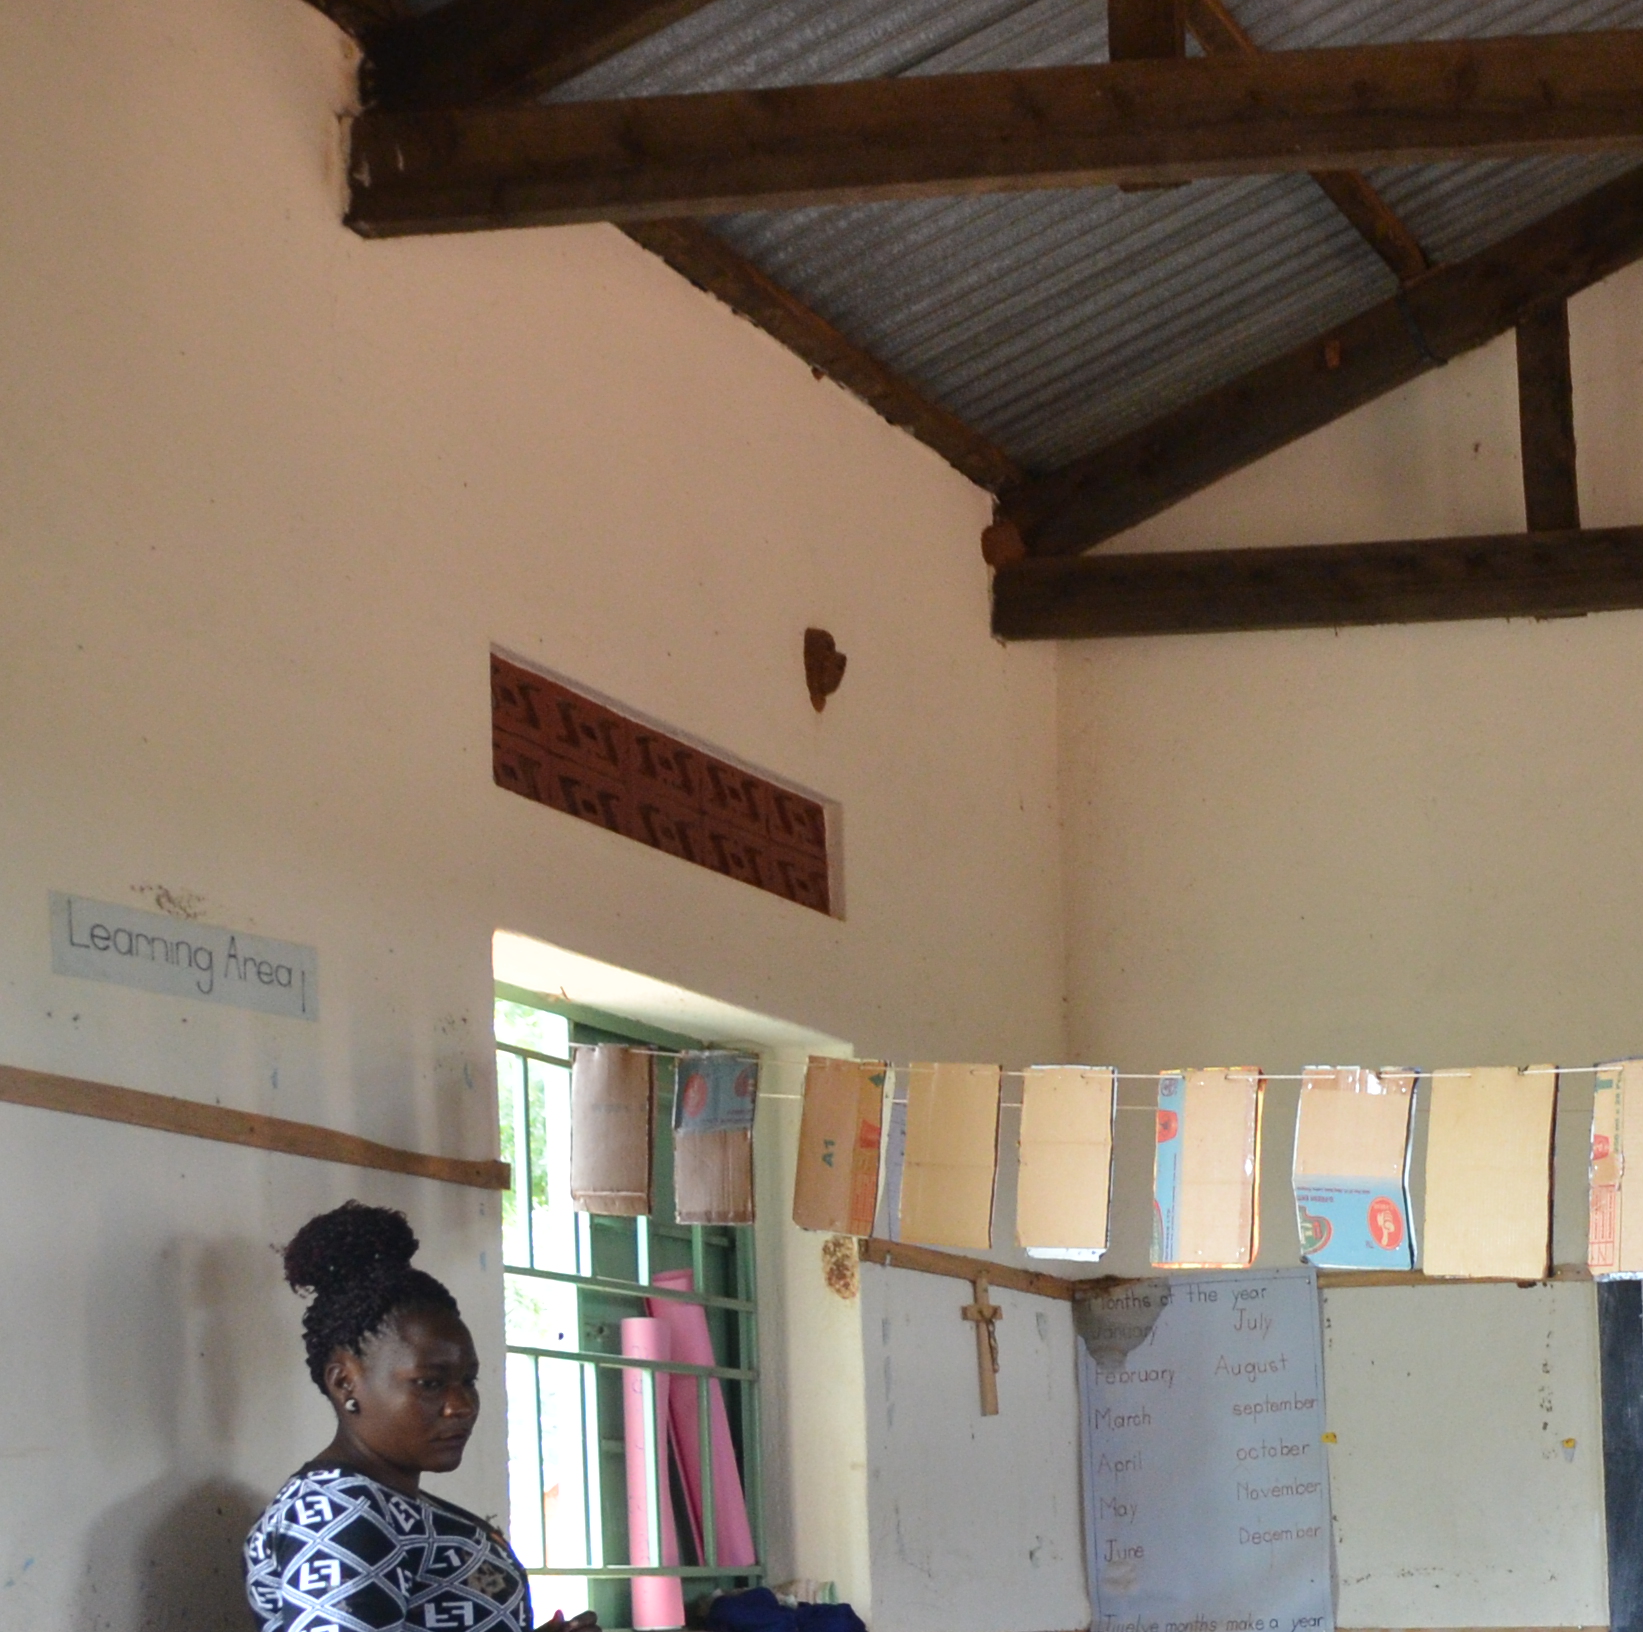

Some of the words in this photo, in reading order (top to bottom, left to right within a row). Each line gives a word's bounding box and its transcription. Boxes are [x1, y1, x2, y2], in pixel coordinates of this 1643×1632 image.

[68, 899, 214, 995] Learning
[224, 935, 293, 988] Area
[1232, 1286, 1267, 1311] year
[1234, 1307, 1273, 1340] July
[1215, 1353, 1289, 1384] August
[1094, 1406, 1152, 1431] March
[1233, 1391, 1317, 1424] september
[1236, 1437, 1311, 1461] october
[1097, 1451, 1143, 1482] April
[1236, 1476, 1322, 1501] November
[1100, 1496, 1138, 1524] May
[1239, 1522, 1322, 1545] December
[1102, 1538, 1145, 1562] June
[1225, 1612, 1265, 1632] make
[1269, 1618, 1279, 1630] a
